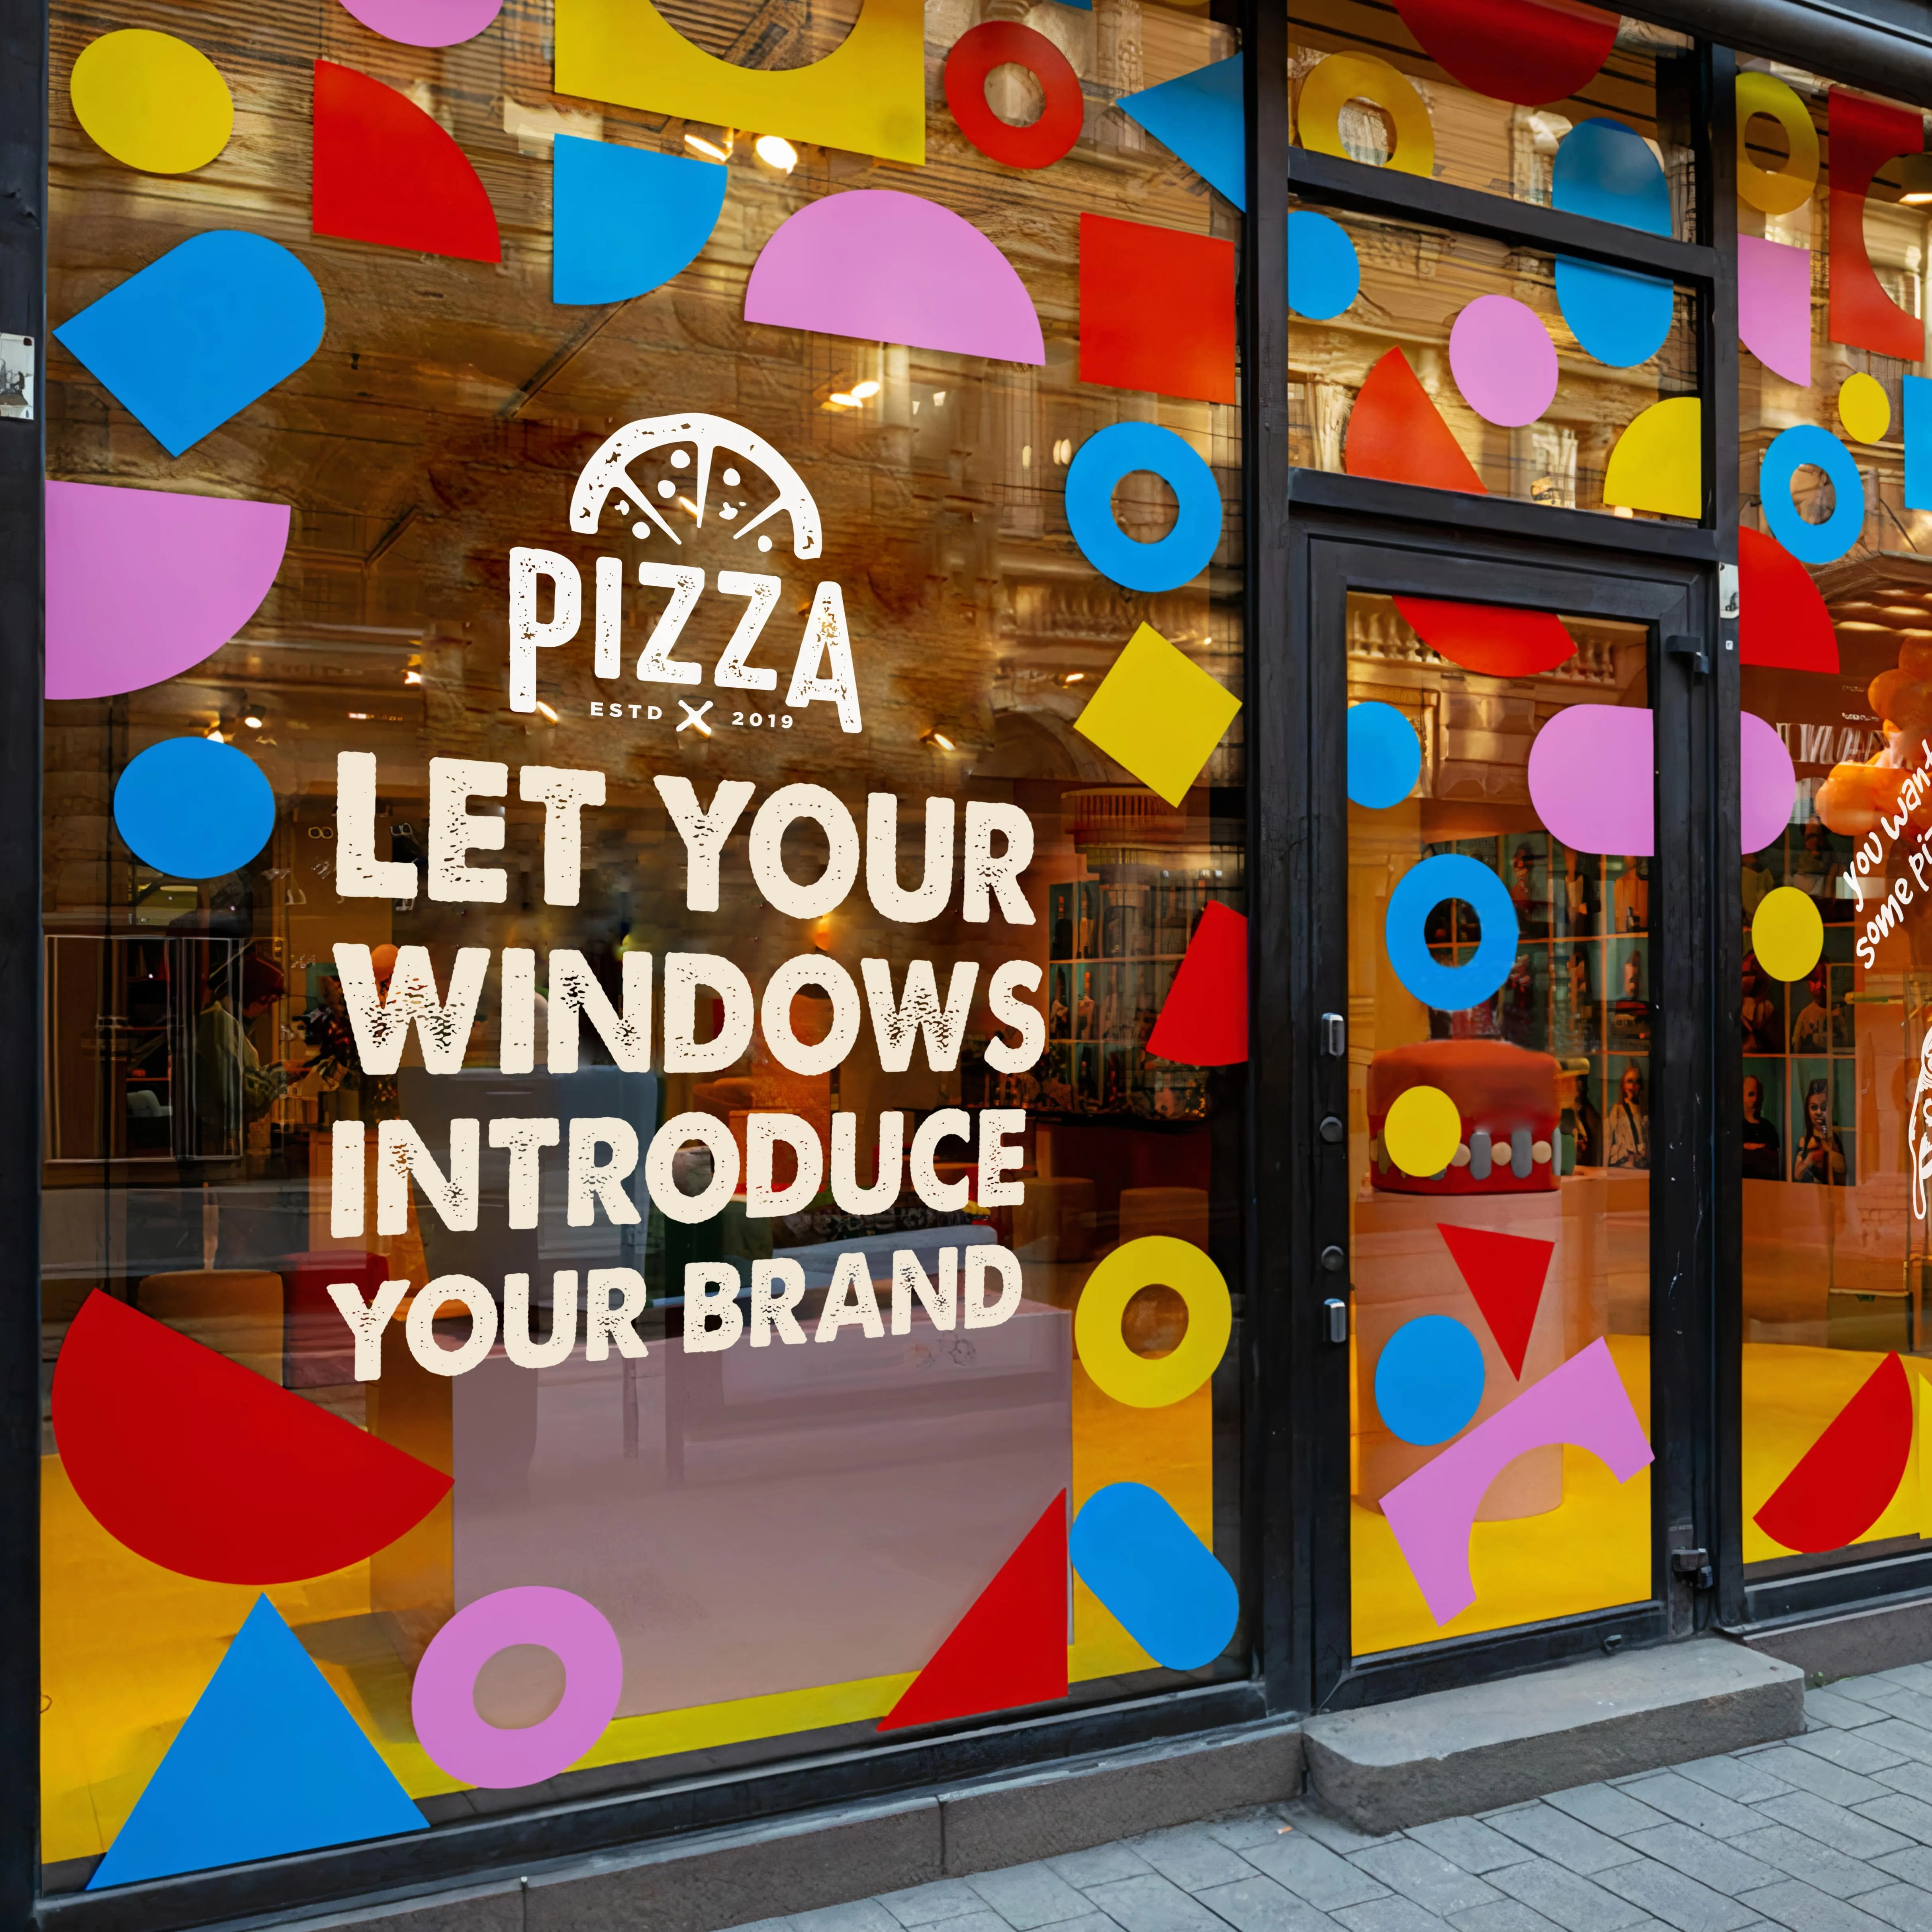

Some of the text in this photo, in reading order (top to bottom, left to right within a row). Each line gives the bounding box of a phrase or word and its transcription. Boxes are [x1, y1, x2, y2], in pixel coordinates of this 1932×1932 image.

[509, 546, 862, 734] PIZZA
[590, 701, 663, 720] ESTD
[731, 711, 793, 729] 2019
[335, 751, 1036, 925] LET YOUR
[1842, 831, 1883, 913] you
[1856, 878, 1914, 969] some
[332, 942, 1047, 1076] WINDOWS
[330, 1108, 1027, 1239] INTRODUCE
[326, 1244, 1024, 1382] YOUR BRAND
